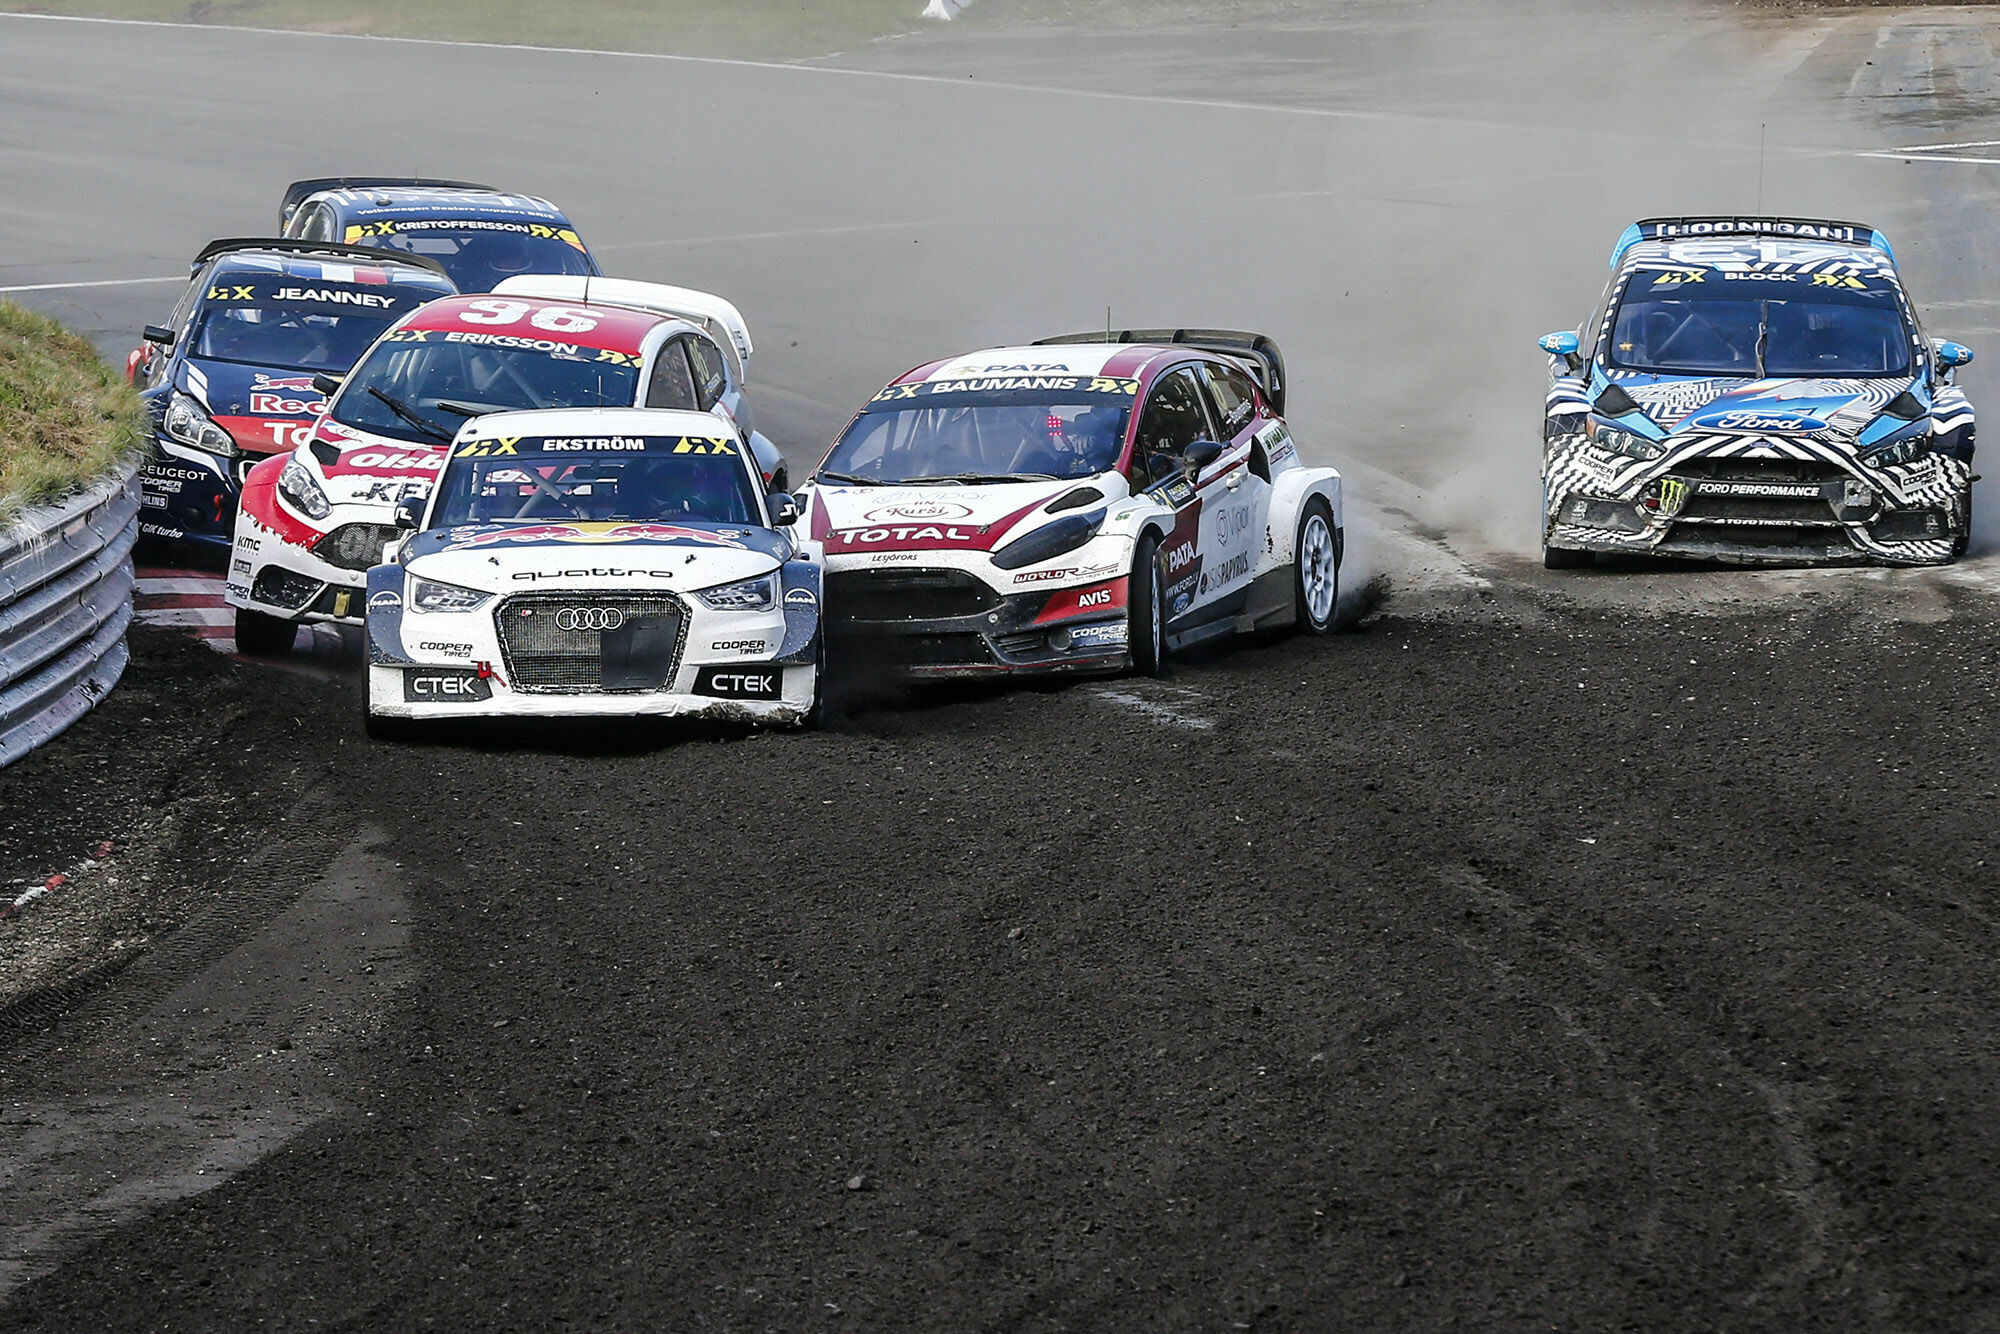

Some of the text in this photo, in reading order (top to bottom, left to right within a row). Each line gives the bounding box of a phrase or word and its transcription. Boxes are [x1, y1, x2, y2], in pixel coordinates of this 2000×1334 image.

[395, 220, 530, 233] KRISTOFFERSSON
[1724, 272, 1797, 282] BLOCK
[271, 287, 397, 309] JEANNEY
[458, 299, 605, 334] 96
[444, 331, 579, 355] ERIKSSON
[983, 363, 1070, 373] PATA
[930, 377, 1079, 395] BAUMANIS
[1717, 411, 1803, 430] Ford
[542, 436, 646, 452] EKSTRÖM
[1577, 456, 1614, 475] COOPER
[1903, 469, 1937, 486] COOPER
[1698, 483, 1820, 497] FORD PERFORMANCE
[157, 526, 184, 539] turbo
[837, 526, 972, 545] TOTAL
[237, 535, 262, 551] KMC
[871, 553, 919, 563] LESJÖFORS
[1169, 541, 1197, 573] PATA
[511, 568, 674, 582] quattro
[1078, 590, 1112, 608] AVIS
[1072, 625, 1127, 639] COOPER
[419, 641, 474, 652] COOPER
[711, 640, 766, 650] COOPER
[443, 650, 471, 658] TIRES
[413, 676, 476, 694] CTEK
[711, 674, 774, 693] CTEK
